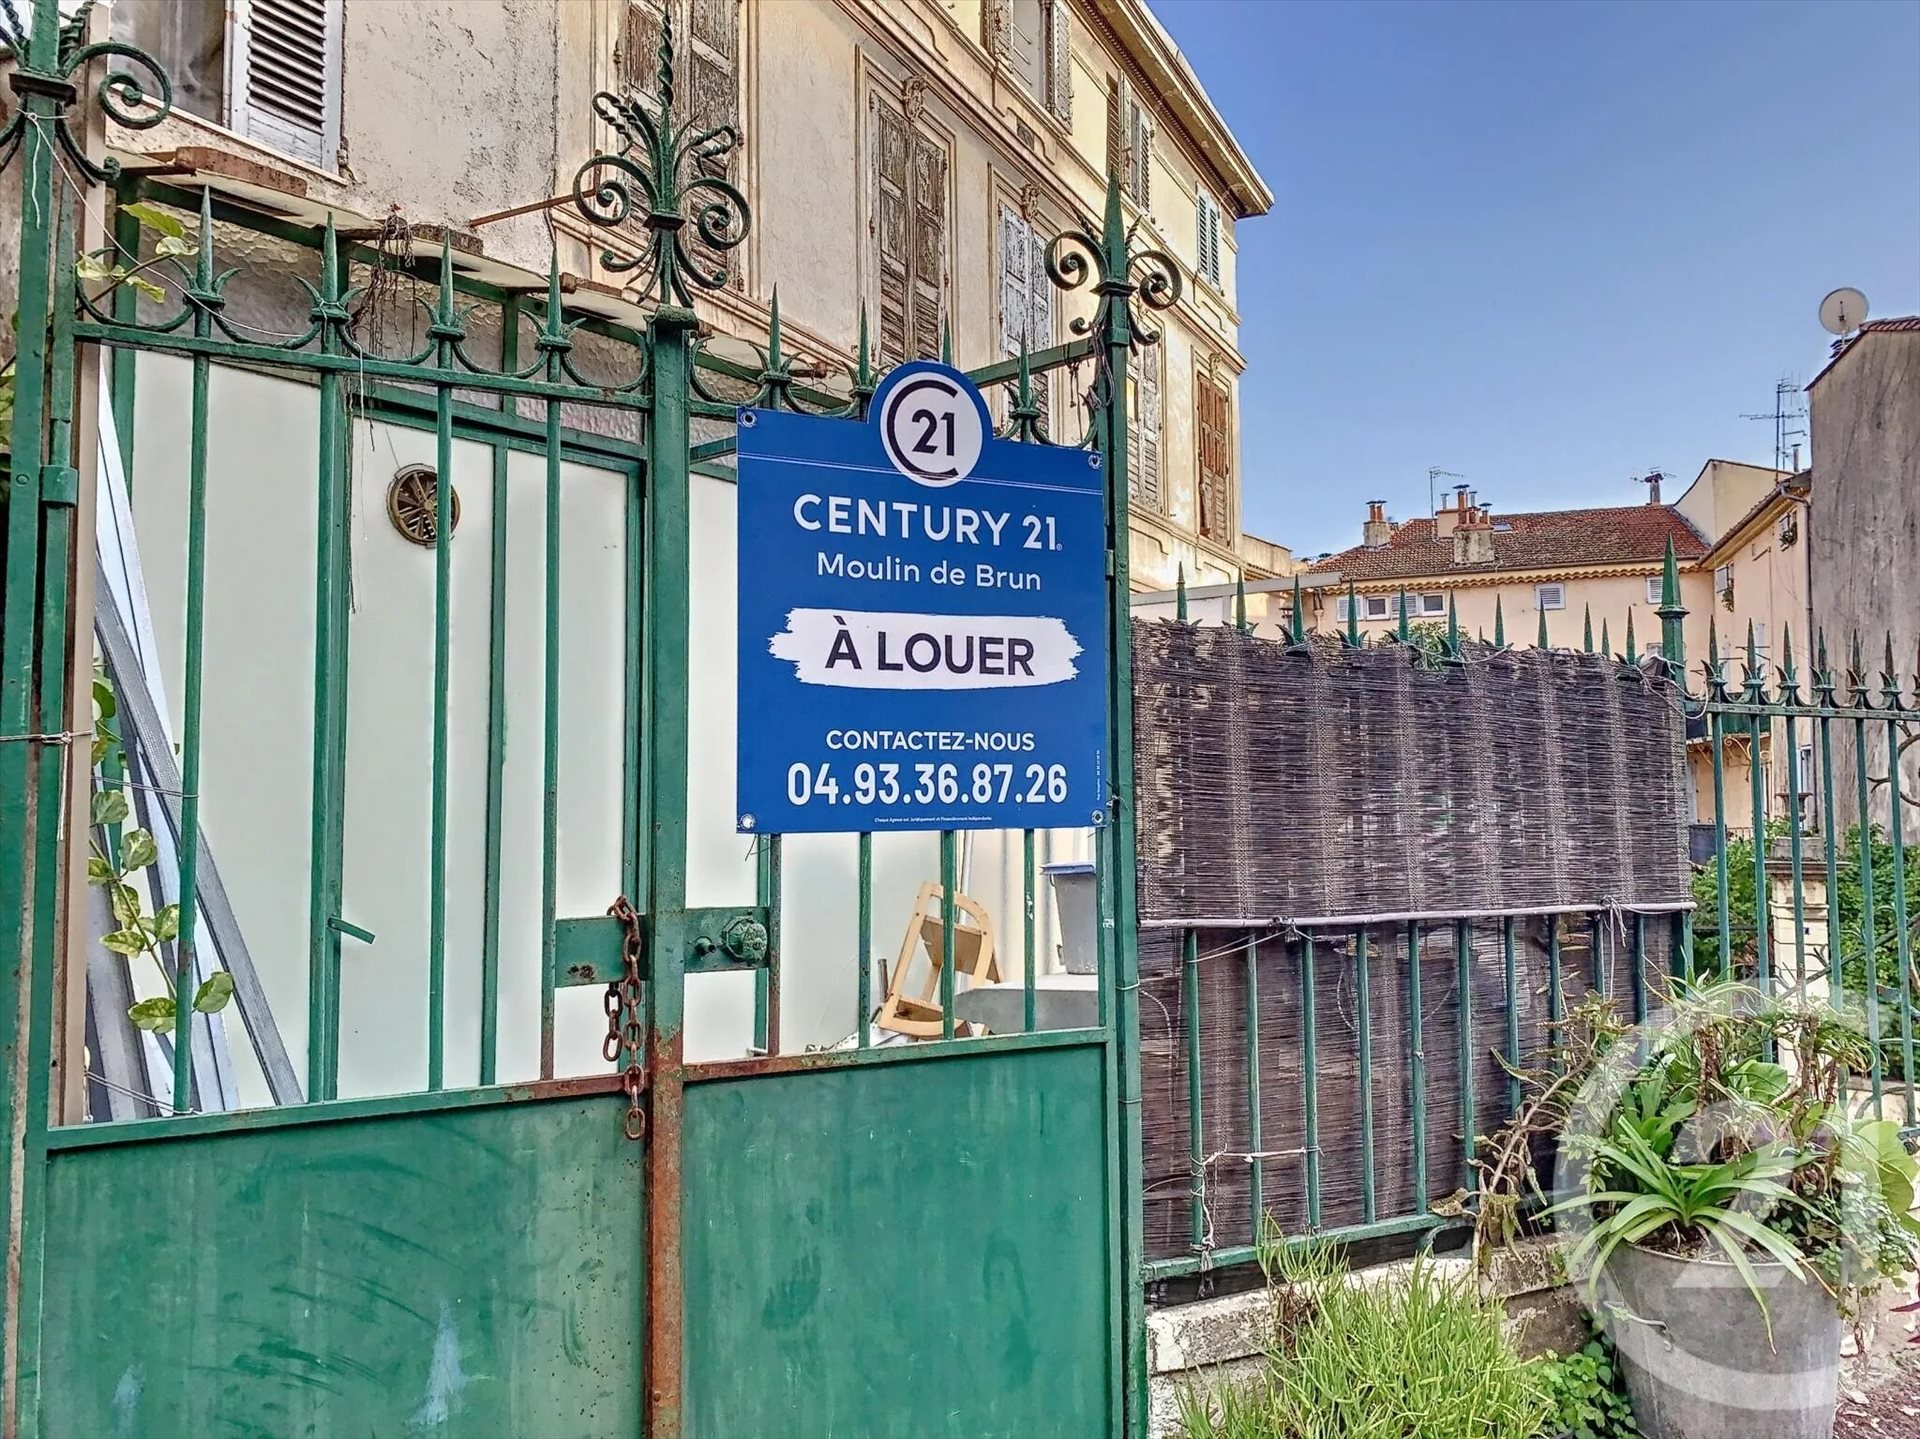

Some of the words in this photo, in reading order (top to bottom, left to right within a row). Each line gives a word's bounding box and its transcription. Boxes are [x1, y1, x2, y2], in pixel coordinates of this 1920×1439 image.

[911, 408, 955, 457] 21
[793, 494, 1011, 549] CENTURY
[817, 552, 920, 584] Moulin
[930, 560, 966, 587] de
[976, 565, 1042, 591] Brun
[825, 615, 862, 670] À
[877, 631, 1035, 677] LOUER
[826, 730, 1035, 752] CONTACTEZ-NOUS
[787, 763, 1067, 806] 04.93.36.87.26
